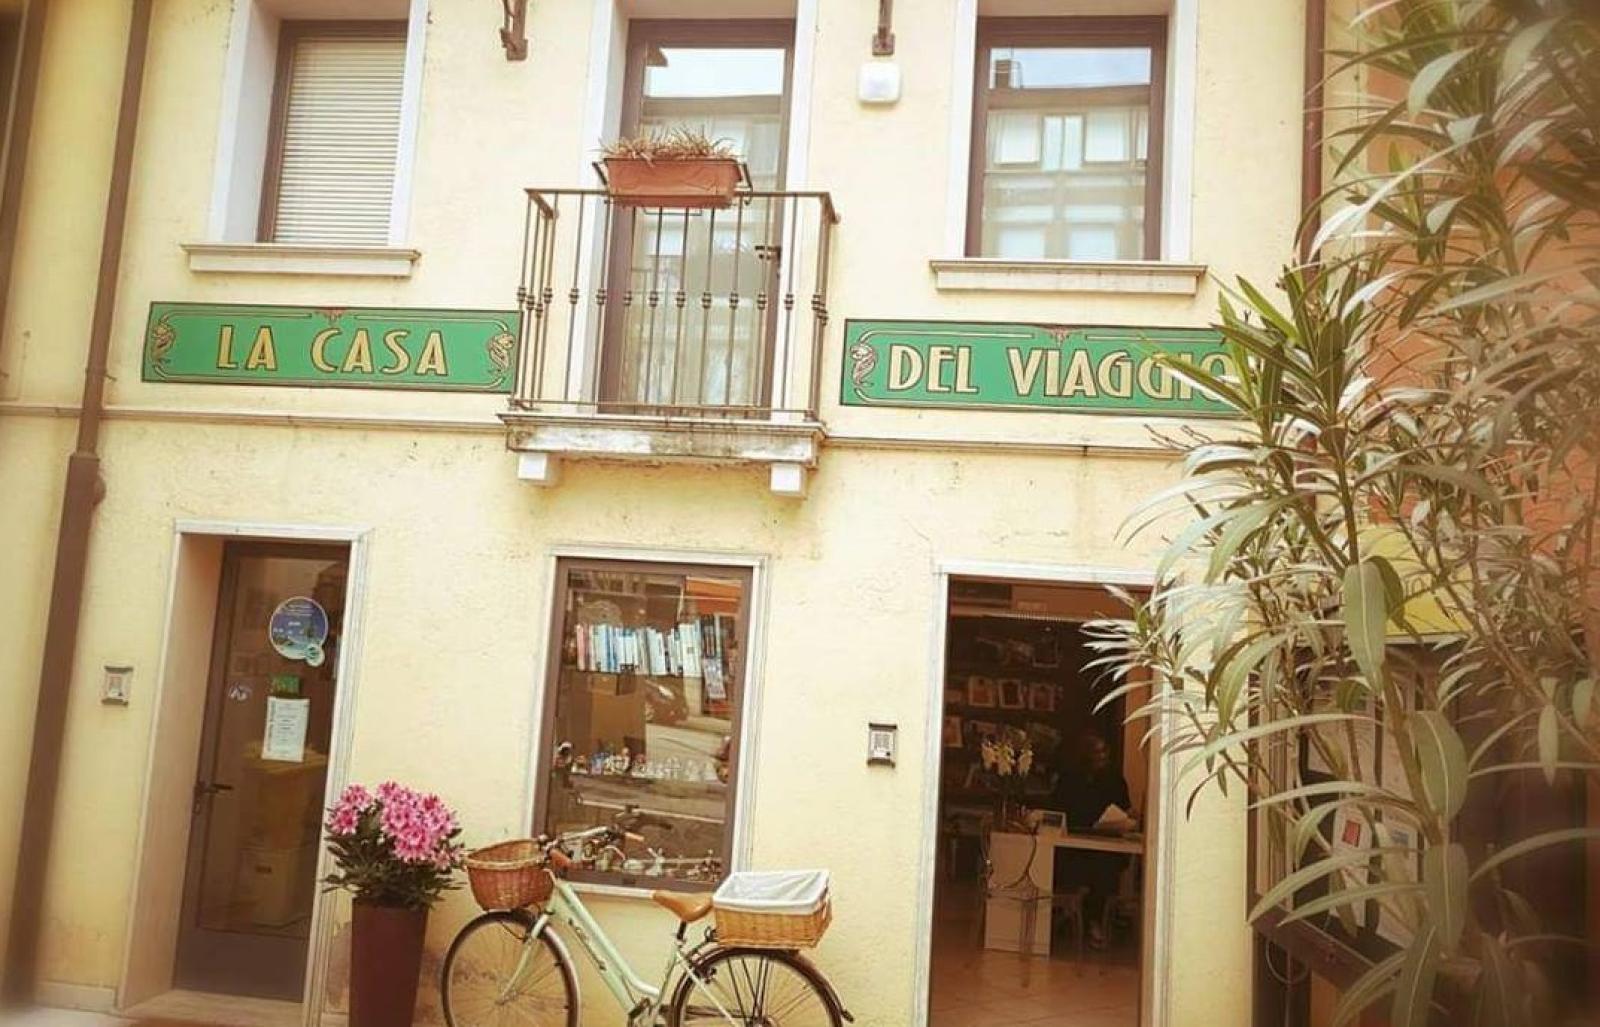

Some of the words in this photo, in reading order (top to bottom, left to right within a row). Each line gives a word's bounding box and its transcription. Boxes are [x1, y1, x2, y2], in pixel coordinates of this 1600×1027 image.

[216, 324, 278, 371] LA
[310, 327, 449, 376] CASA
[886, 343, 979, 394] DEL
[1006, 347, 1240, 402] VIAGGIO
